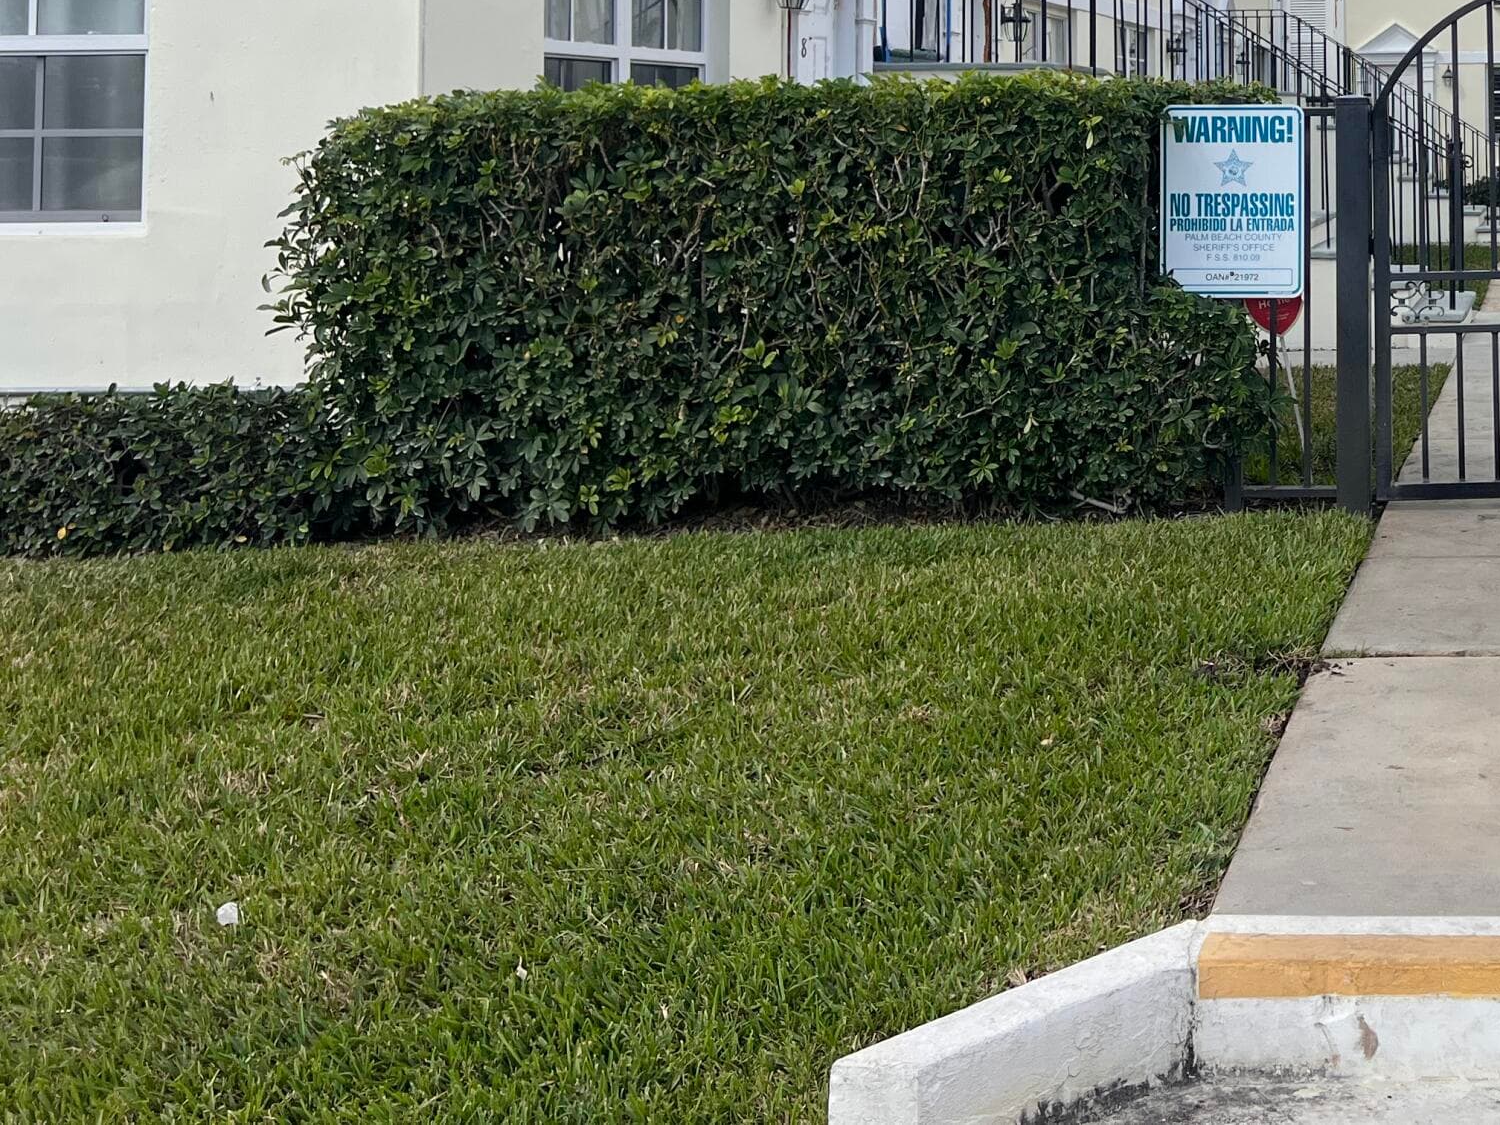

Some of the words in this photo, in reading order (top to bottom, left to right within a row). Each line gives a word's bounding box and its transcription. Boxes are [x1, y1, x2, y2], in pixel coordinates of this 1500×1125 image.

[801, 37, 807, 59] 8
[1171, 115, 1293, 143] WARNING!
[1170, 193, 1191, 217] NO
[1195, 193, 1295, 217] TRESPASSING
[1170, 218, 1227, 232] PROHIBIDO
[1230, 218, 1243, 232] LA
[1246, 218, 1295, 232] ENTRADA
[1185, 233, 1209, 241] PALM
[1210, 233, 1243, 241] BEACH
[1245, 233, 1282, 241] COUNTY
[1193, 243, 1240, 251] SHERIFF'S
[1241, 243, 1275, 251] OFFICE
